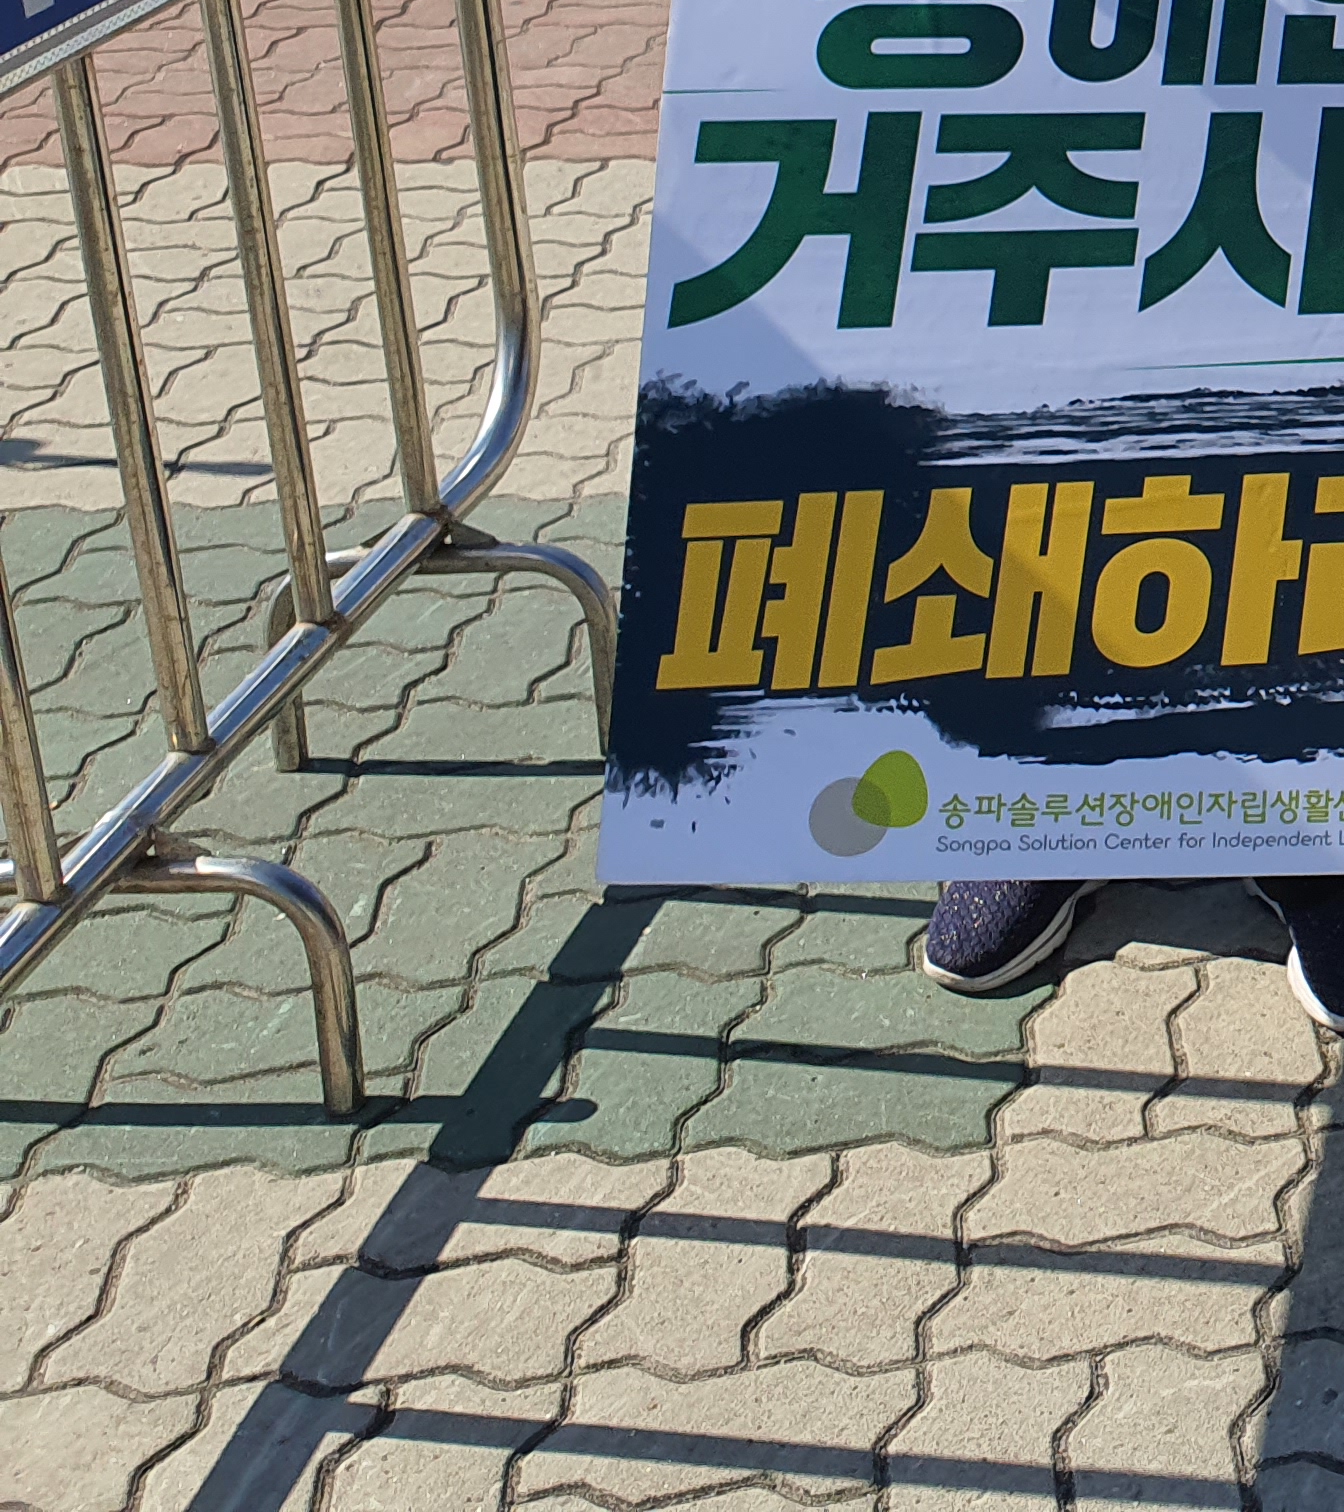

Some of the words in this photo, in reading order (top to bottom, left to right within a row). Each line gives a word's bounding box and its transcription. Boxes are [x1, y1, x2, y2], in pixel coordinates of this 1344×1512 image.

[935, 834, 1012, 856] Songpa
[1017, 833, 1097, 852] Solution
[1104, 832, 1172, 850] Center
[1178, 832, 1203, 849] for
[1212, 830, 1333, 852] Independent
